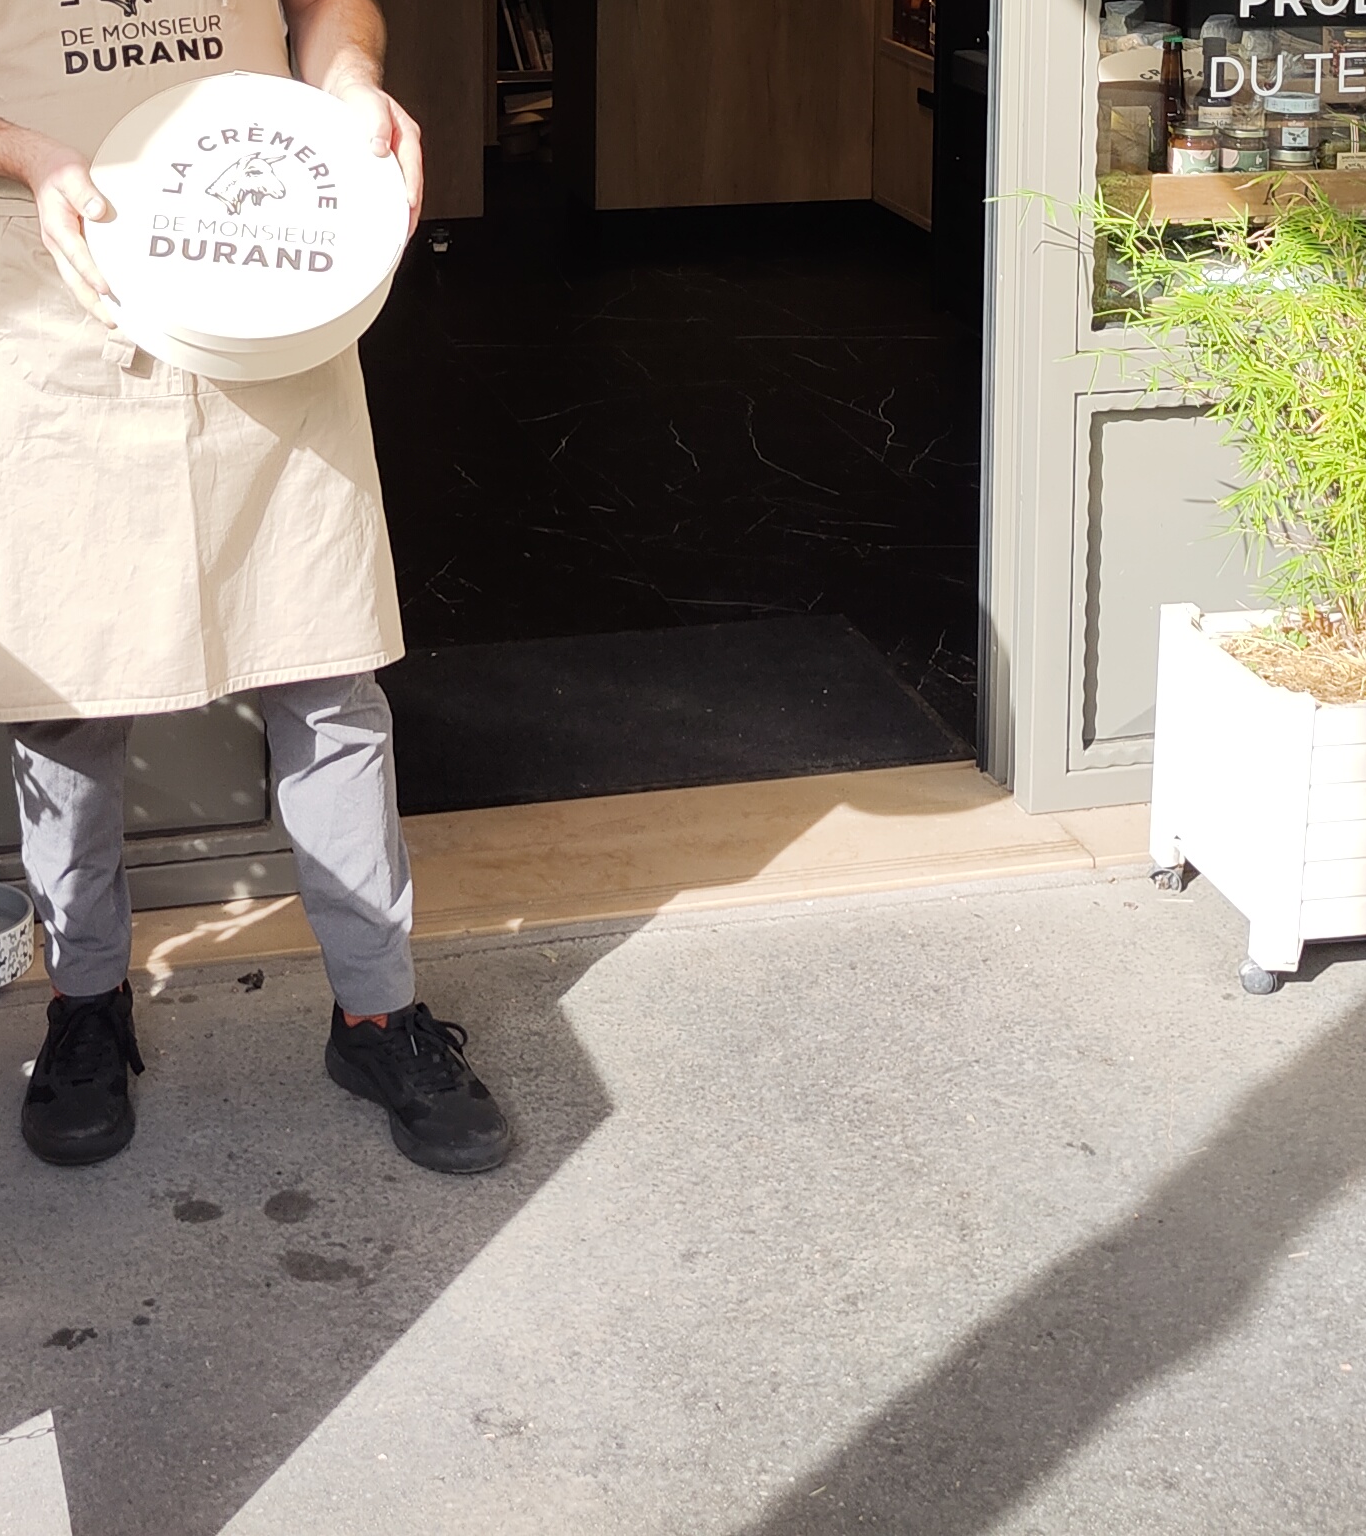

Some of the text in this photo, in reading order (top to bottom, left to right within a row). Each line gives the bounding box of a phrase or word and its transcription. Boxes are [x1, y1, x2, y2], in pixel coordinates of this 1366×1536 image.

[61, 13, 222, 48] DE MONSIEUR
[64, 36, 224, 75] DURAND
[1210, 53, 1283, 98] DU
[162, 122, 339, 211] LA CRÈMERIE
[152, 213, 337, 247] DE MONSIEUR
[148, 235, 335, 274] DURAND
